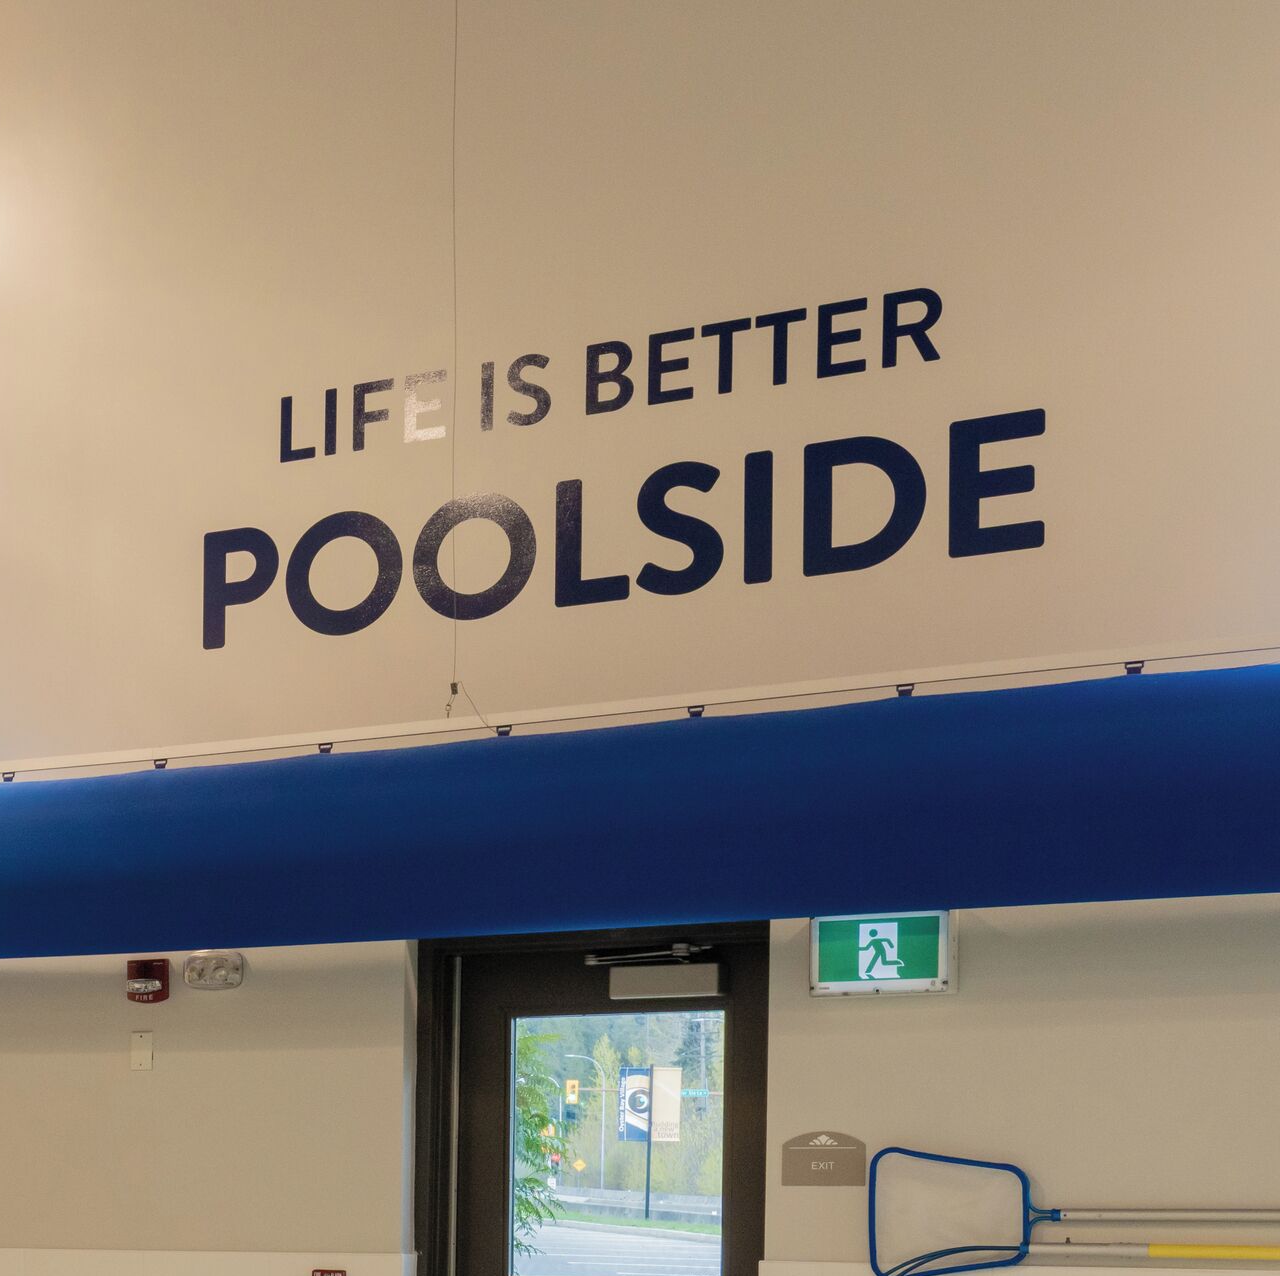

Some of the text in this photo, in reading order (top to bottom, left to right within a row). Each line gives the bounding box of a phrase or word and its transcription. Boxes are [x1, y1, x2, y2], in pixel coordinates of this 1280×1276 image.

[279, 287, 943, 464] LIFE IS BETTER
[202, 407, 1047, 651] POOLSIDE
[811, 1161, 835, 1171] EXIT
